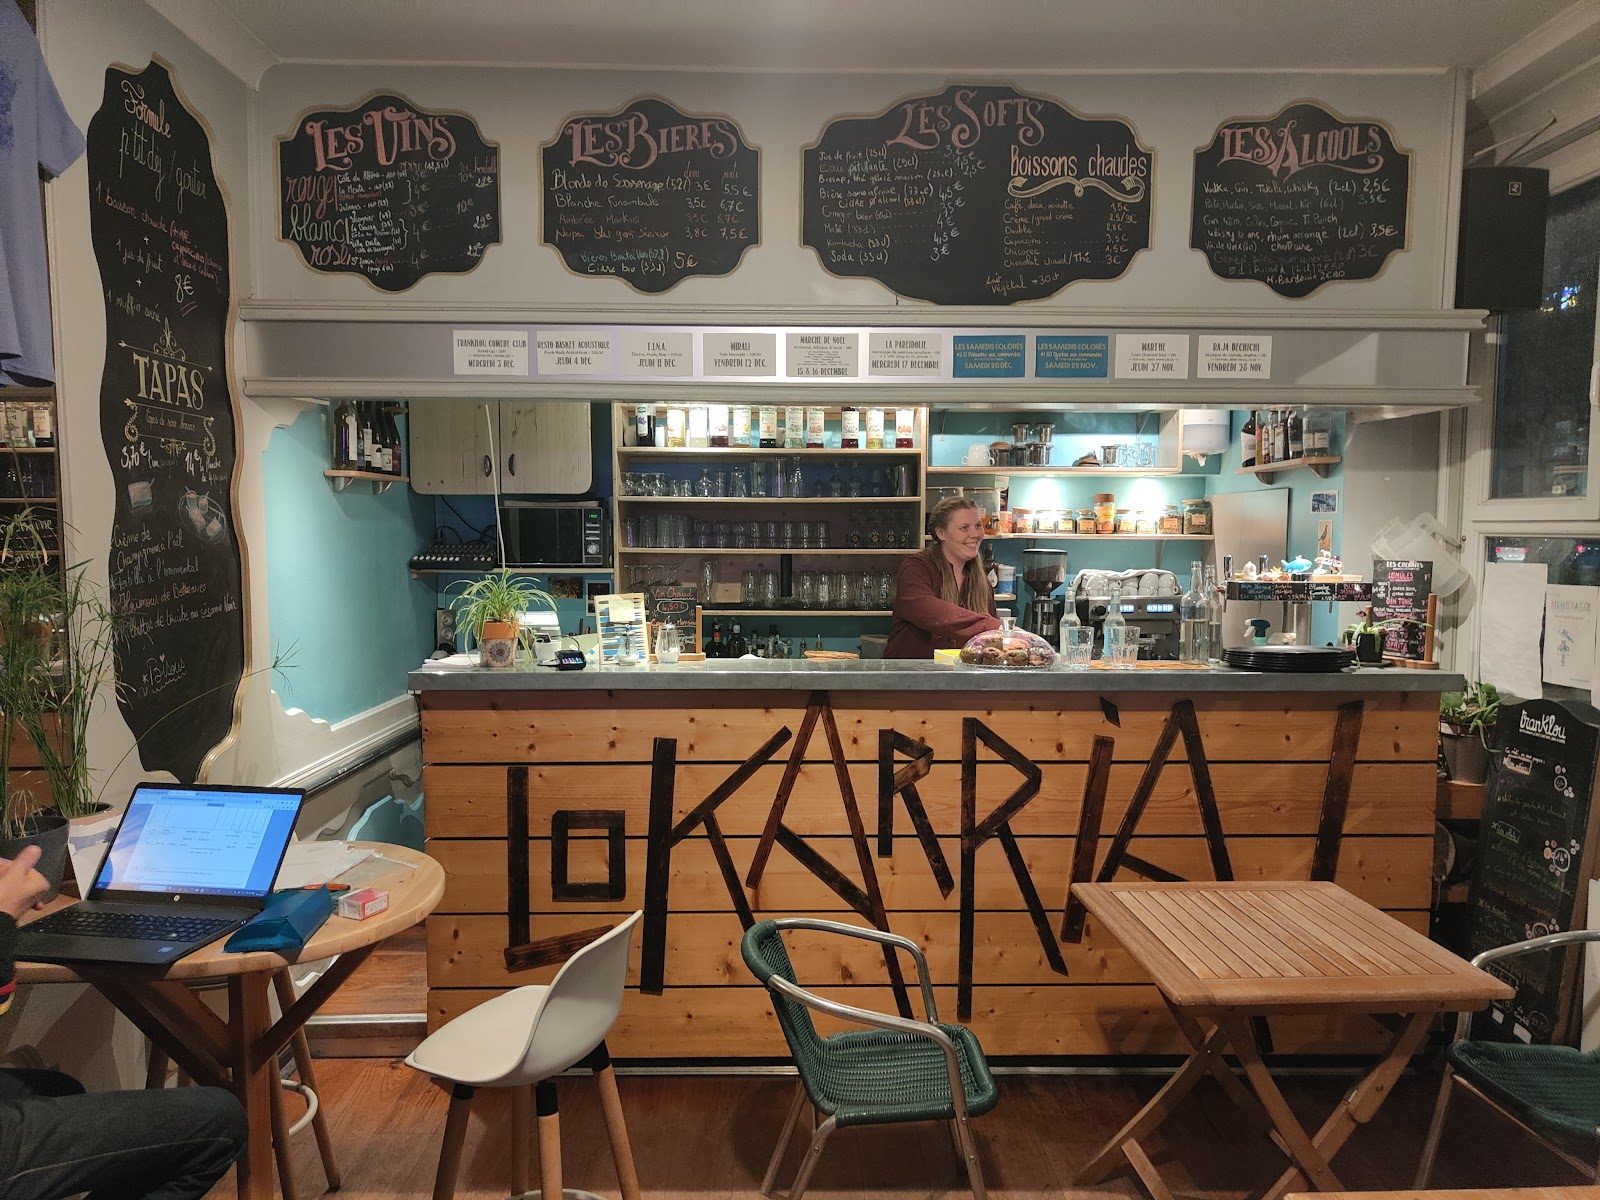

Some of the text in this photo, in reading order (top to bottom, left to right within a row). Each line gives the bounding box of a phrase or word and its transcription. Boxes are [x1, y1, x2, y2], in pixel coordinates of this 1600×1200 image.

[886, 88, 1045, 150] LES SOFTS
[305, 106, 456, 172] LES VINS
[565, 118, 619, 168] LES
[1217, 120, 1384, 182] LES ALCOOLS
[1010, 144, 1148, 177] boissons chaudes
[554, 194, 602, 208] Blanche
[289, 203, 345, 242] blanc
[830, 250, 855, 263] Soda
[488, 339, 510, 348] COMEDY
[512, 339, 527, 348] CLUB
[555, 340, 575, 349] BASKET
[577, 340, 610, 350] ACOUSTIQUE
[823, 336, 831, 344] DE
[885, 340, 893, 349] LA
[1141, 342, 1166, 351] MARTHE
[468, 359, 496, 368] MERCREDI
[555, 357, 572, 365] JEUDI
[573, 357, 579, 365] 4
[637, 358, 655, 368] JEUDI
[713, 358, 743, 368] VENDREDI
[871, 360, 900, 369] MERCREDI
[910, 360, 940, 369] DECEMBRE
[797, 368, 804, 376] 15
[812, 368, 819, 376] 16
[820, 367, 848, 376] DECEMBRE
[1130, 363, 1149, 371] JEUDI
[1151, 363, 1160, 371] 27
[1207, 363, 1237, 371] VENDREDI
[133, 351, 204, 411] TAPAS
